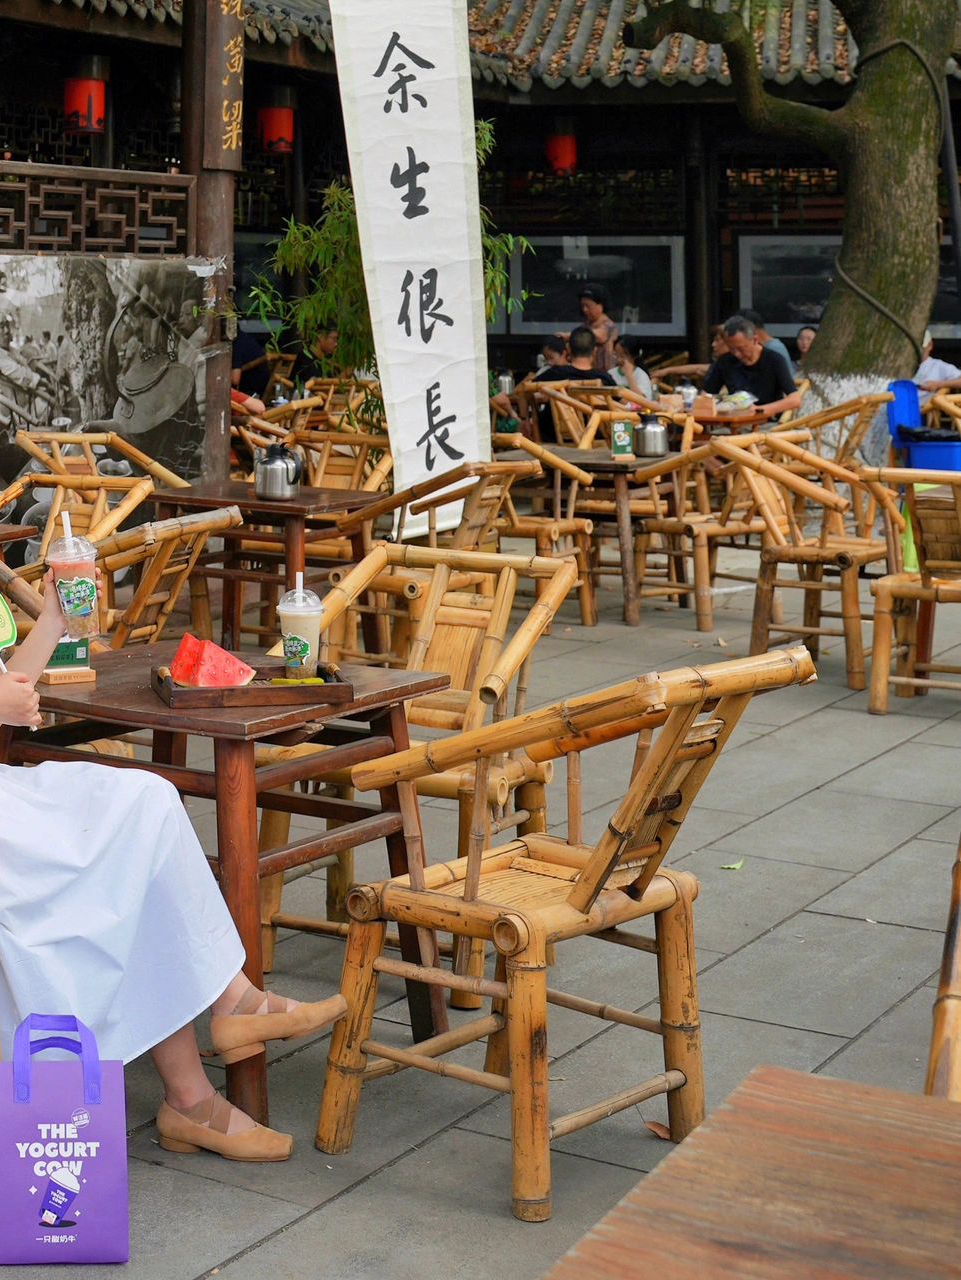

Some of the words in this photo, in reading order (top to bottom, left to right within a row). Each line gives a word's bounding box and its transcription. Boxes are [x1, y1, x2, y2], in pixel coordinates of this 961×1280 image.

[37, 1123, 79, 1140] THE
[15, 1141, 101, 1158] YOGURT
[33, 1160, 84, 1177] COW
